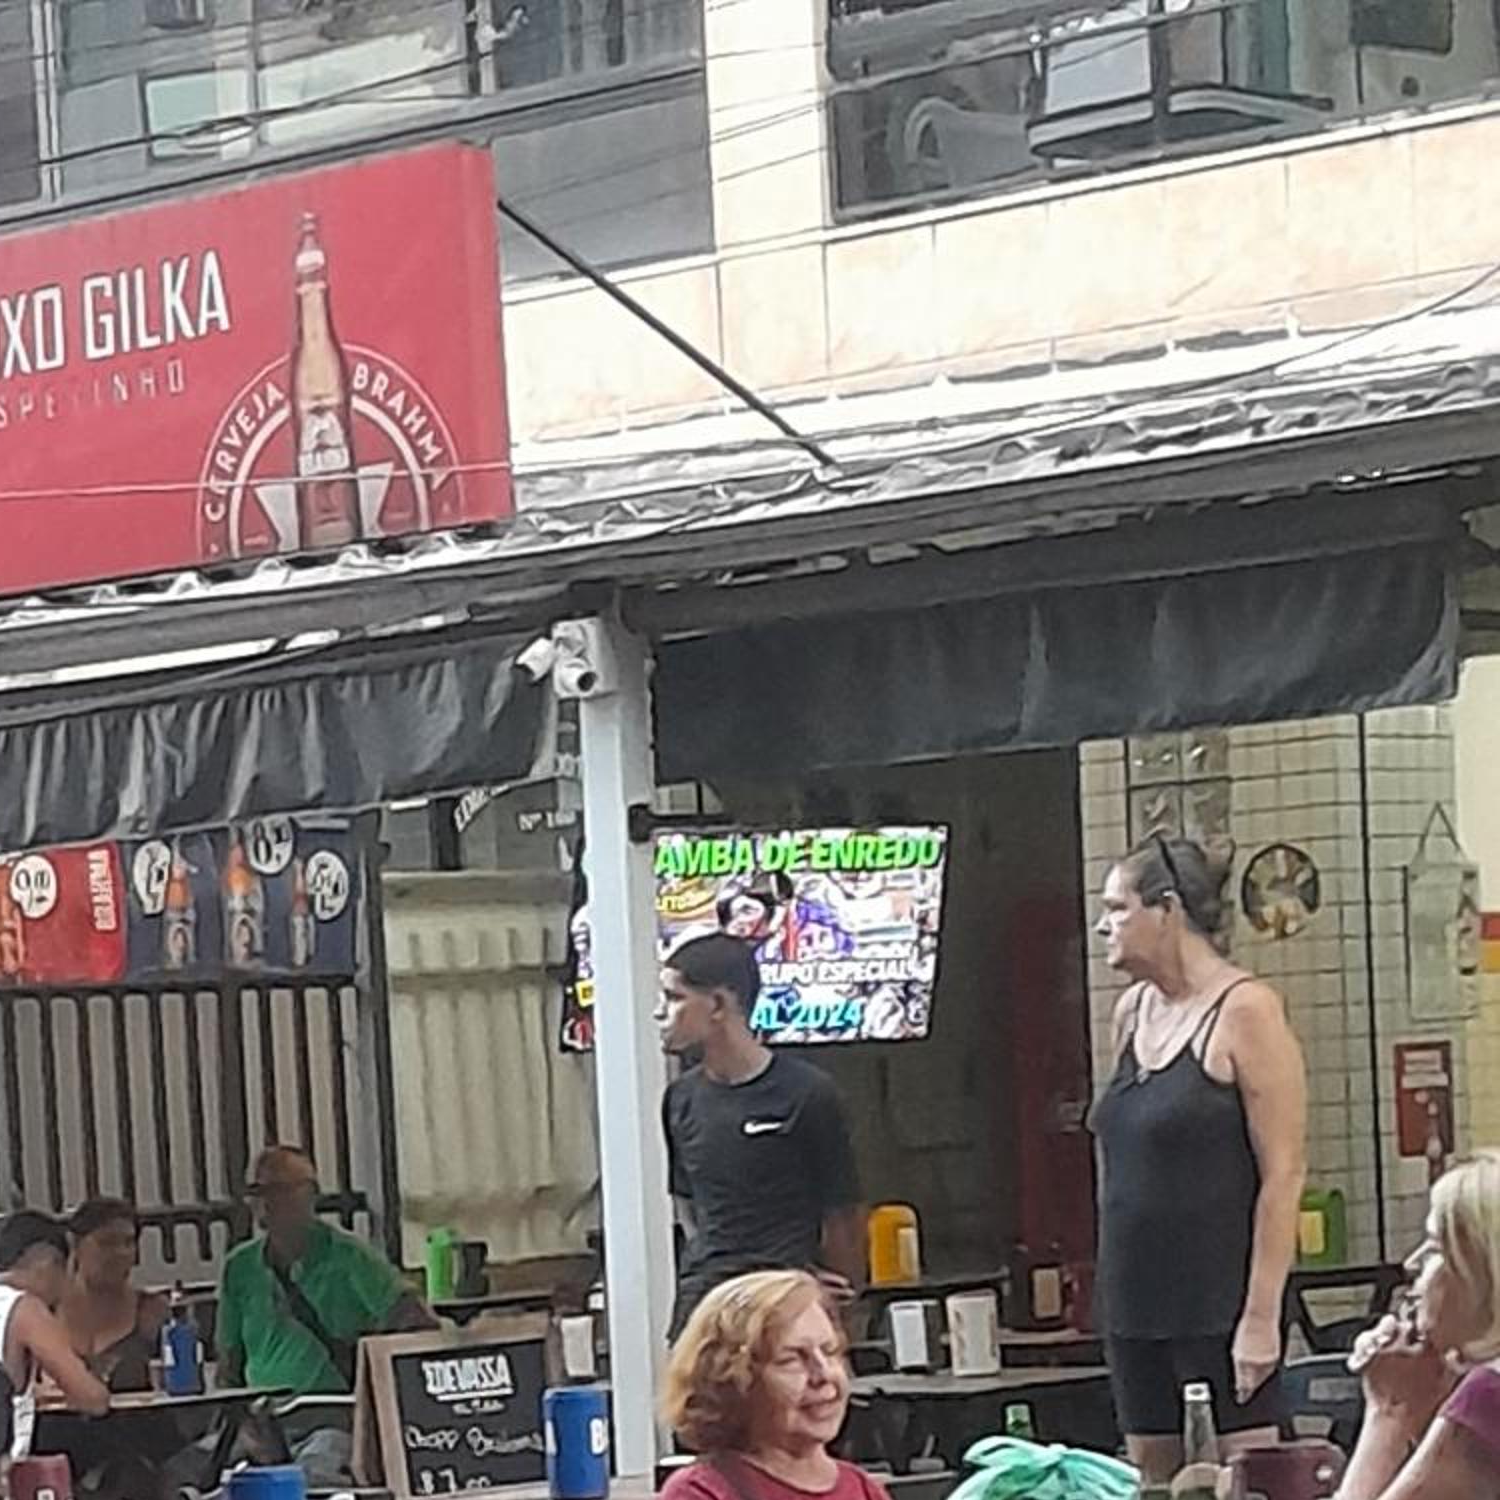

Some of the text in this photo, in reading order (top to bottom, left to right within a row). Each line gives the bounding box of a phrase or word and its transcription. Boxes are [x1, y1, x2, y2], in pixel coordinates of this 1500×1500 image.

[83, 249, 231, 360] GILKA
[204, 362, 452, 522] CERVEJA BRAHMA
[654, 834, 941, 874] AMBA DE ENREDO
[758, 958, 908, 985] RUPO ESPECIAL
[797, 1000, 862, 1029] 2024
